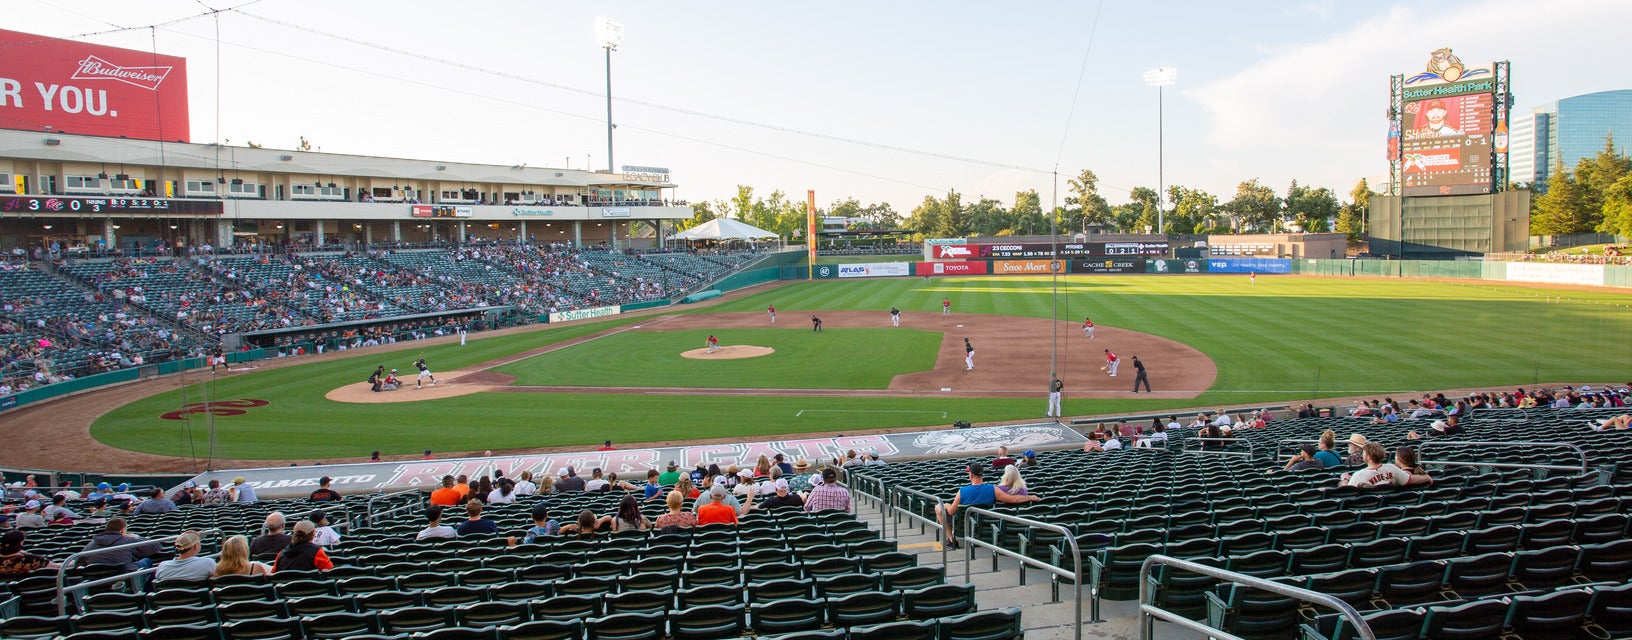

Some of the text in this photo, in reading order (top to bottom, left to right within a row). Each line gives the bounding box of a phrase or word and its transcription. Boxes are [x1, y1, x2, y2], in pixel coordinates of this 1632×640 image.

[78, 59, 162, 81] Budweiser
[1403, 81, 1492, 98] Sutter Health Park
[34, 81, 118, 117] YOU.
[29, 199, 39, 210] 3
[70, 199, 81, 210] 0
[92, 204, 100, 212] 3
[1003, 262, 1046, 272] Save Mart
[566, 306, 613, 320] Sutter Health
[680, 434, 900, 470] CATS
[1368, 473, 1385, 485] WADE
